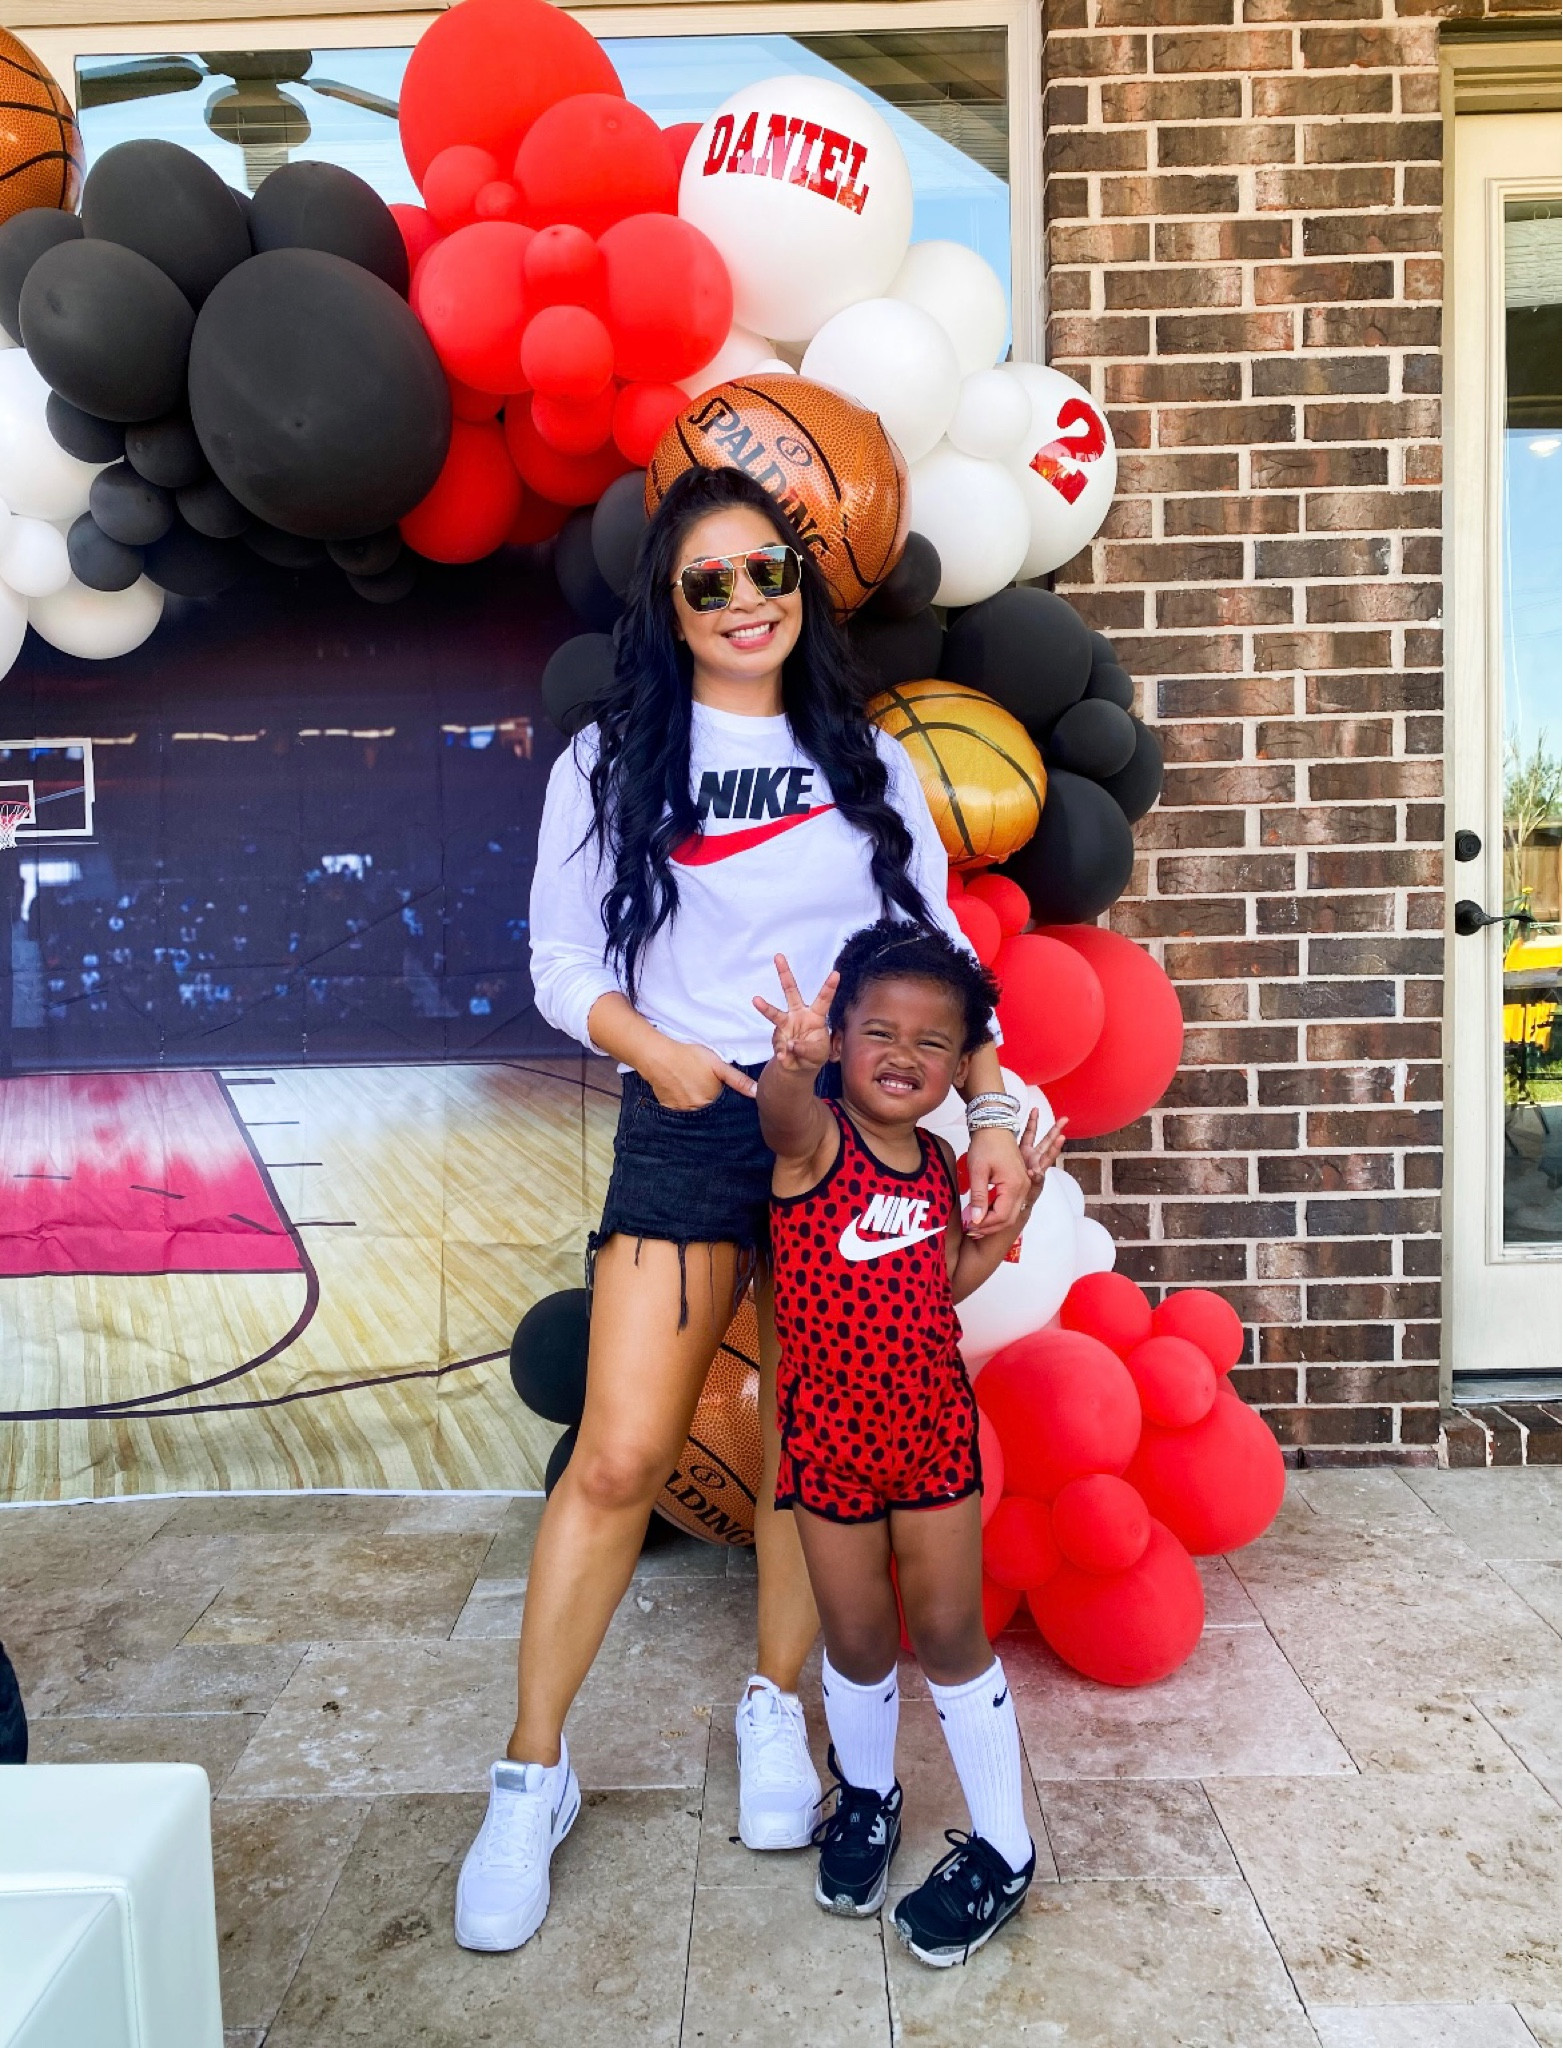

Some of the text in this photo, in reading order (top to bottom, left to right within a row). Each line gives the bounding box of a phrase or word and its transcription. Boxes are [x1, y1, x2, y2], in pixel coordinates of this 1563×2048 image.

[702, 111, 870, 215] DANIEL
[1029, 398, 1108, 506] 2
[697, 766, 815, 820] NIKE
[858, 1193, 930, 1236] NIKE
[665, 1469, 755, 1544] LDING
